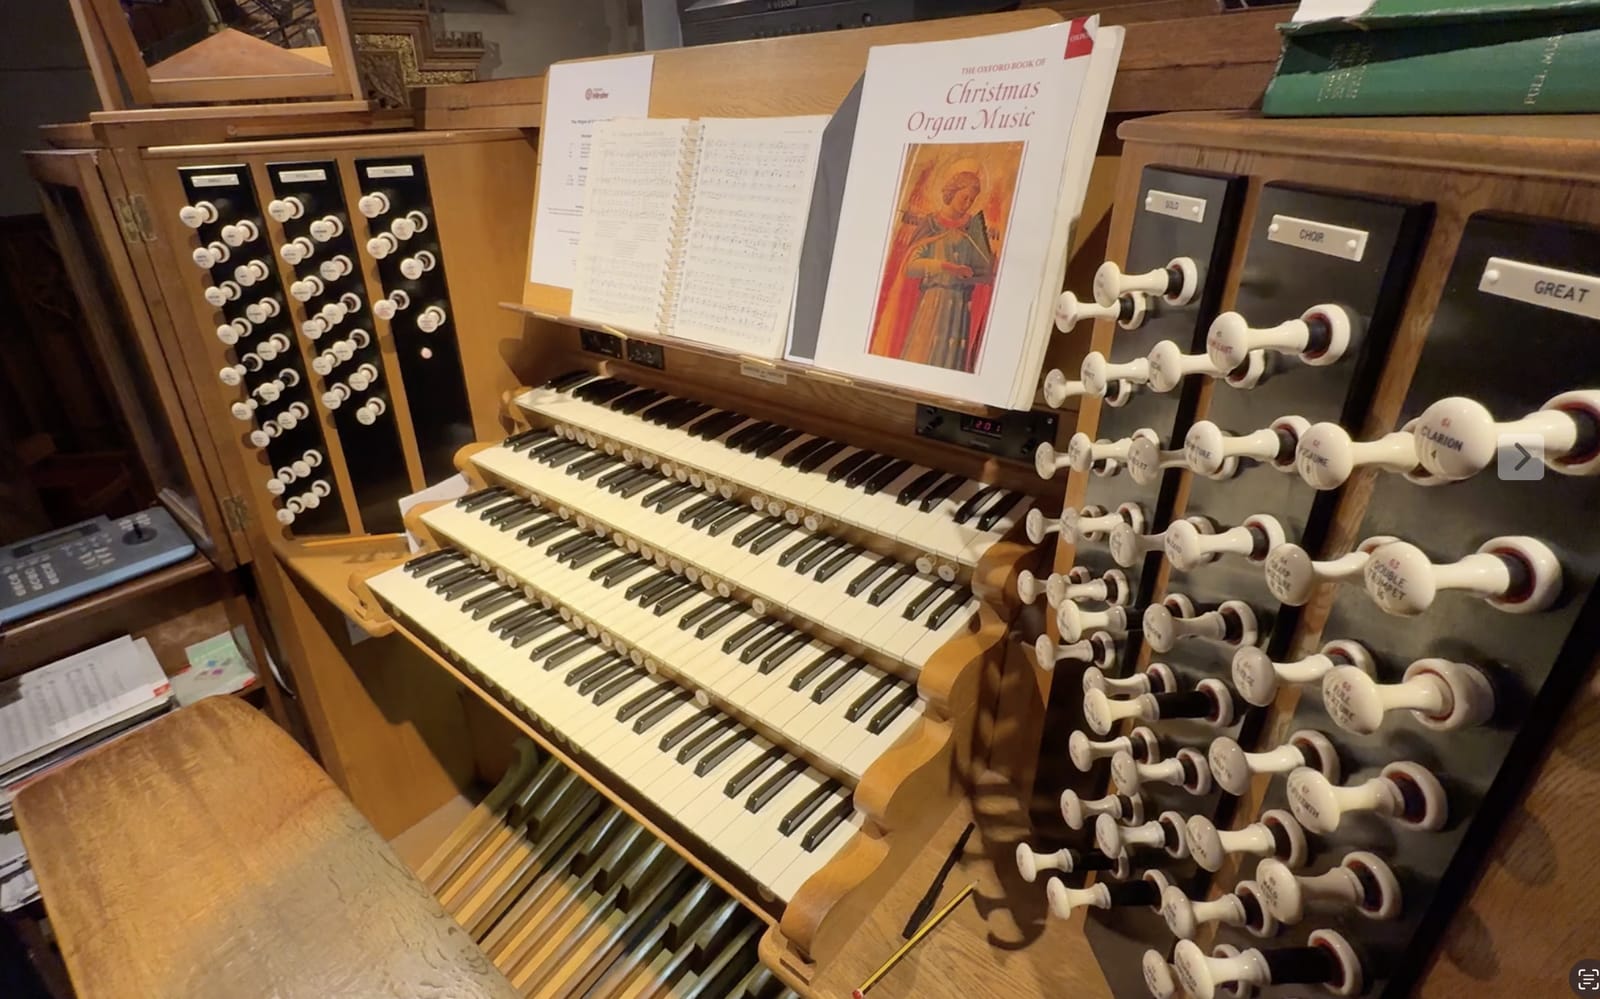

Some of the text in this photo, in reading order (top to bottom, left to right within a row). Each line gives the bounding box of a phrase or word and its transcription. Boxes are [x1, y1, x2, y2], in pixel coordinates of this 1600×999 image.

[961, 57, 1046, 75] THE OXFORD BOOK OF
[946, 78, 1041, 105] Christmas
[907, 105, 1035, 139] Organ Music
[1299, 228, 1325, 243] CHOIR
[1534, 280, 1590, 303] GREAT
[1421, 426, 1463, 452] CLARION
[1370, 567, 1406, 600] TRUMPET
[1375, 560, 1408, 588] DOUBLE
